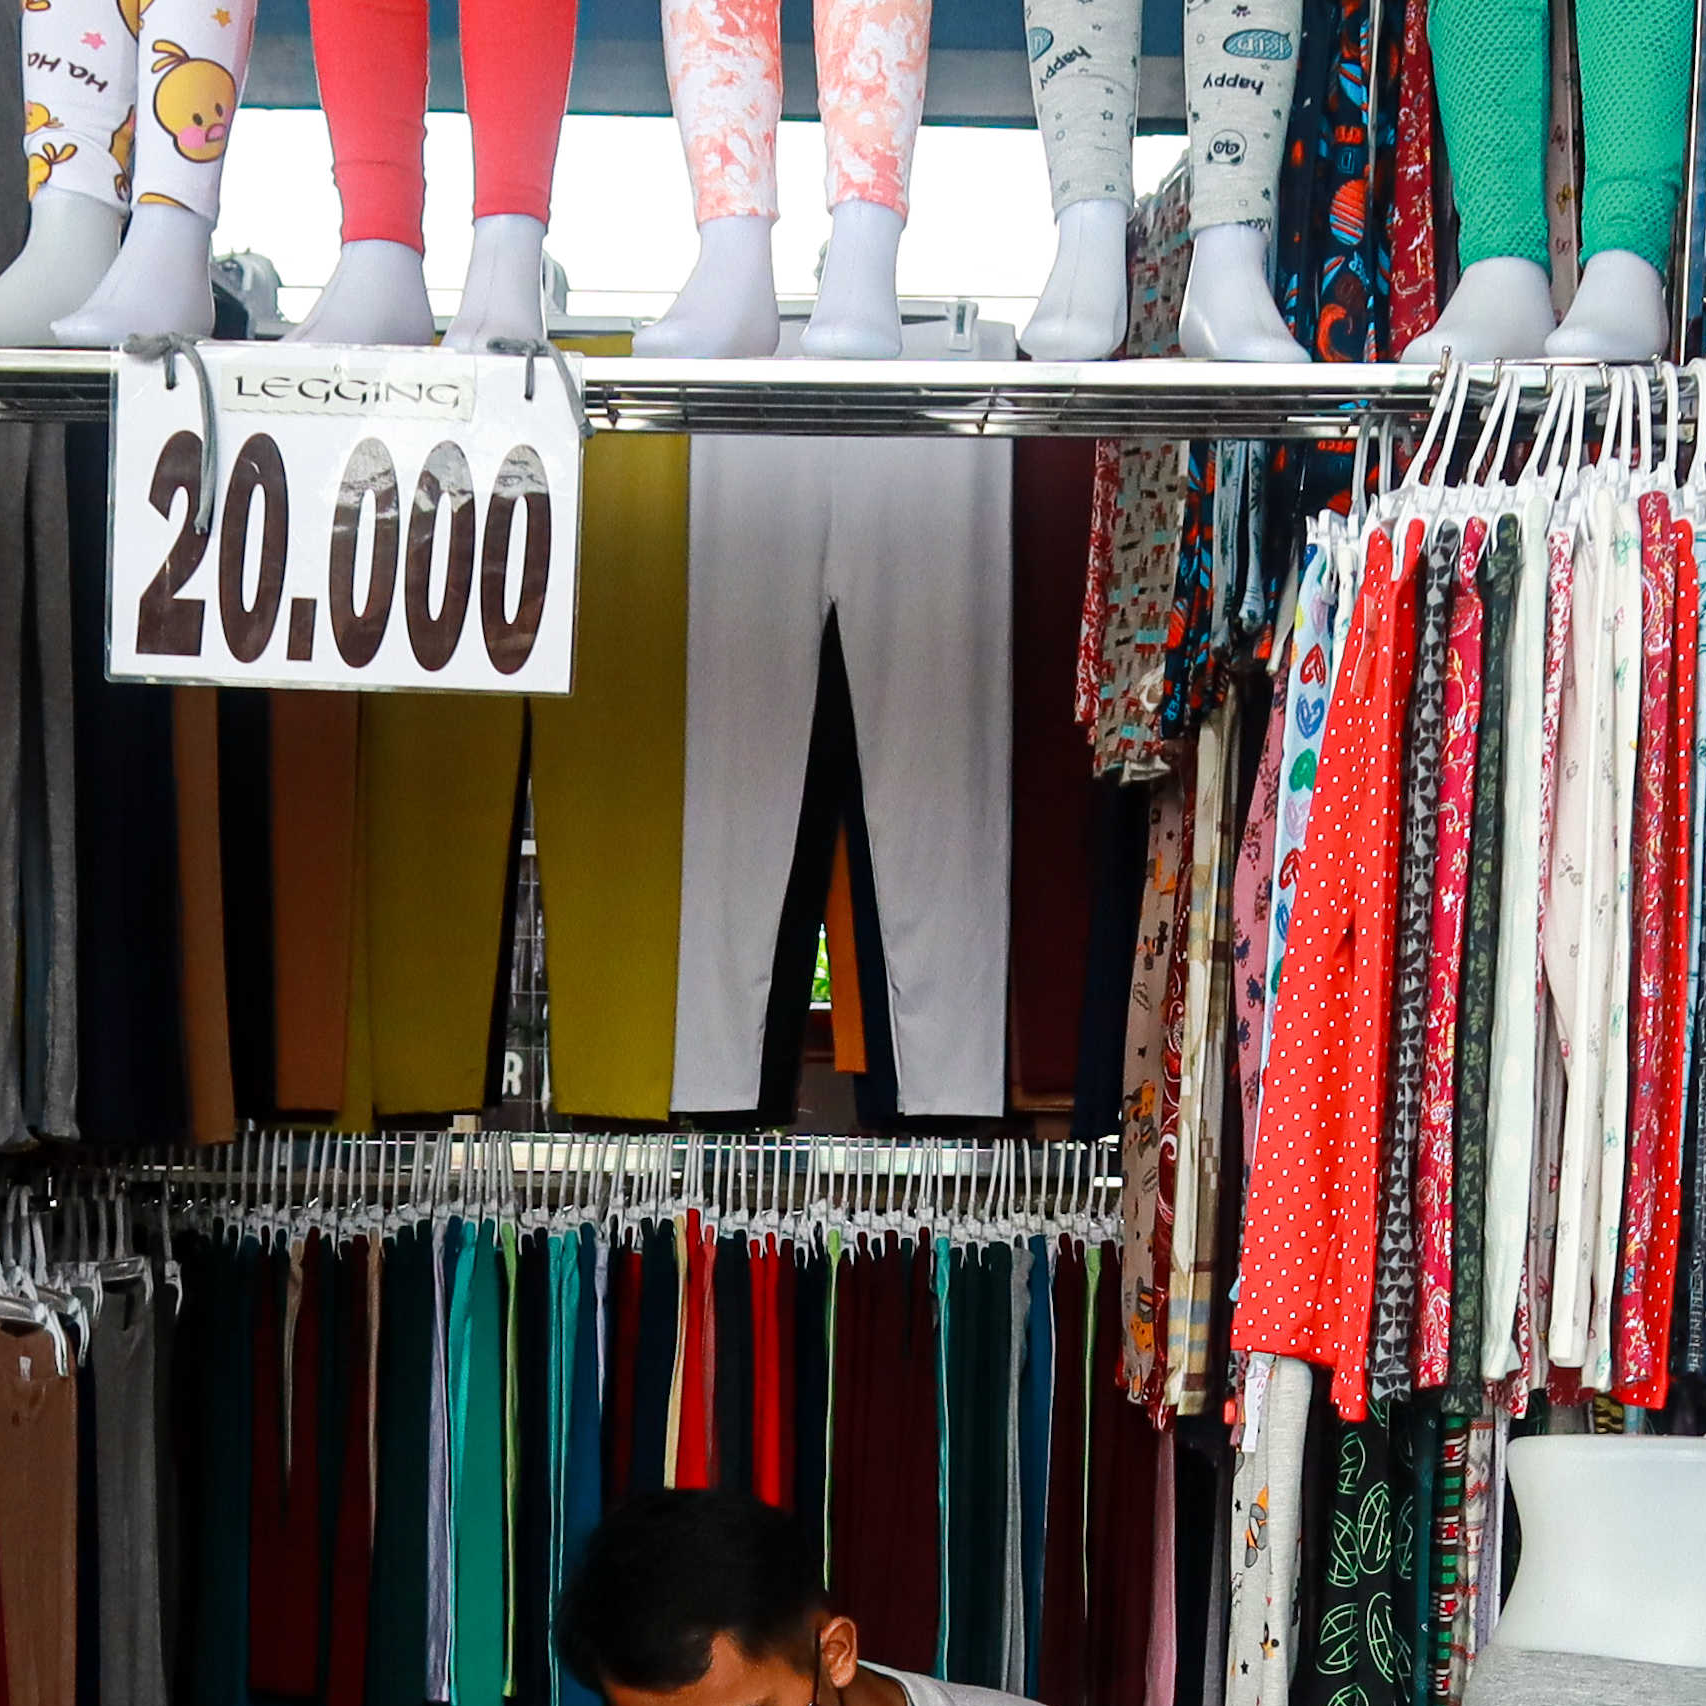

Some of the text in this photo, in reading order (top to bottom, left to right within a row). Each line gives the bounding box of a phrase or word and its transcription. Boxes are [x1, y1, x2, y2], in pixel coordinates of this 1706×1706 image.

[68, 61, 108, 93] Ha
[1038, 46, 1092, 91] happy
[1202, 73, 1265, 96] happy
[234, 375, 462, 410] LEGGING
[136, 430, 553, 676] 20.000
